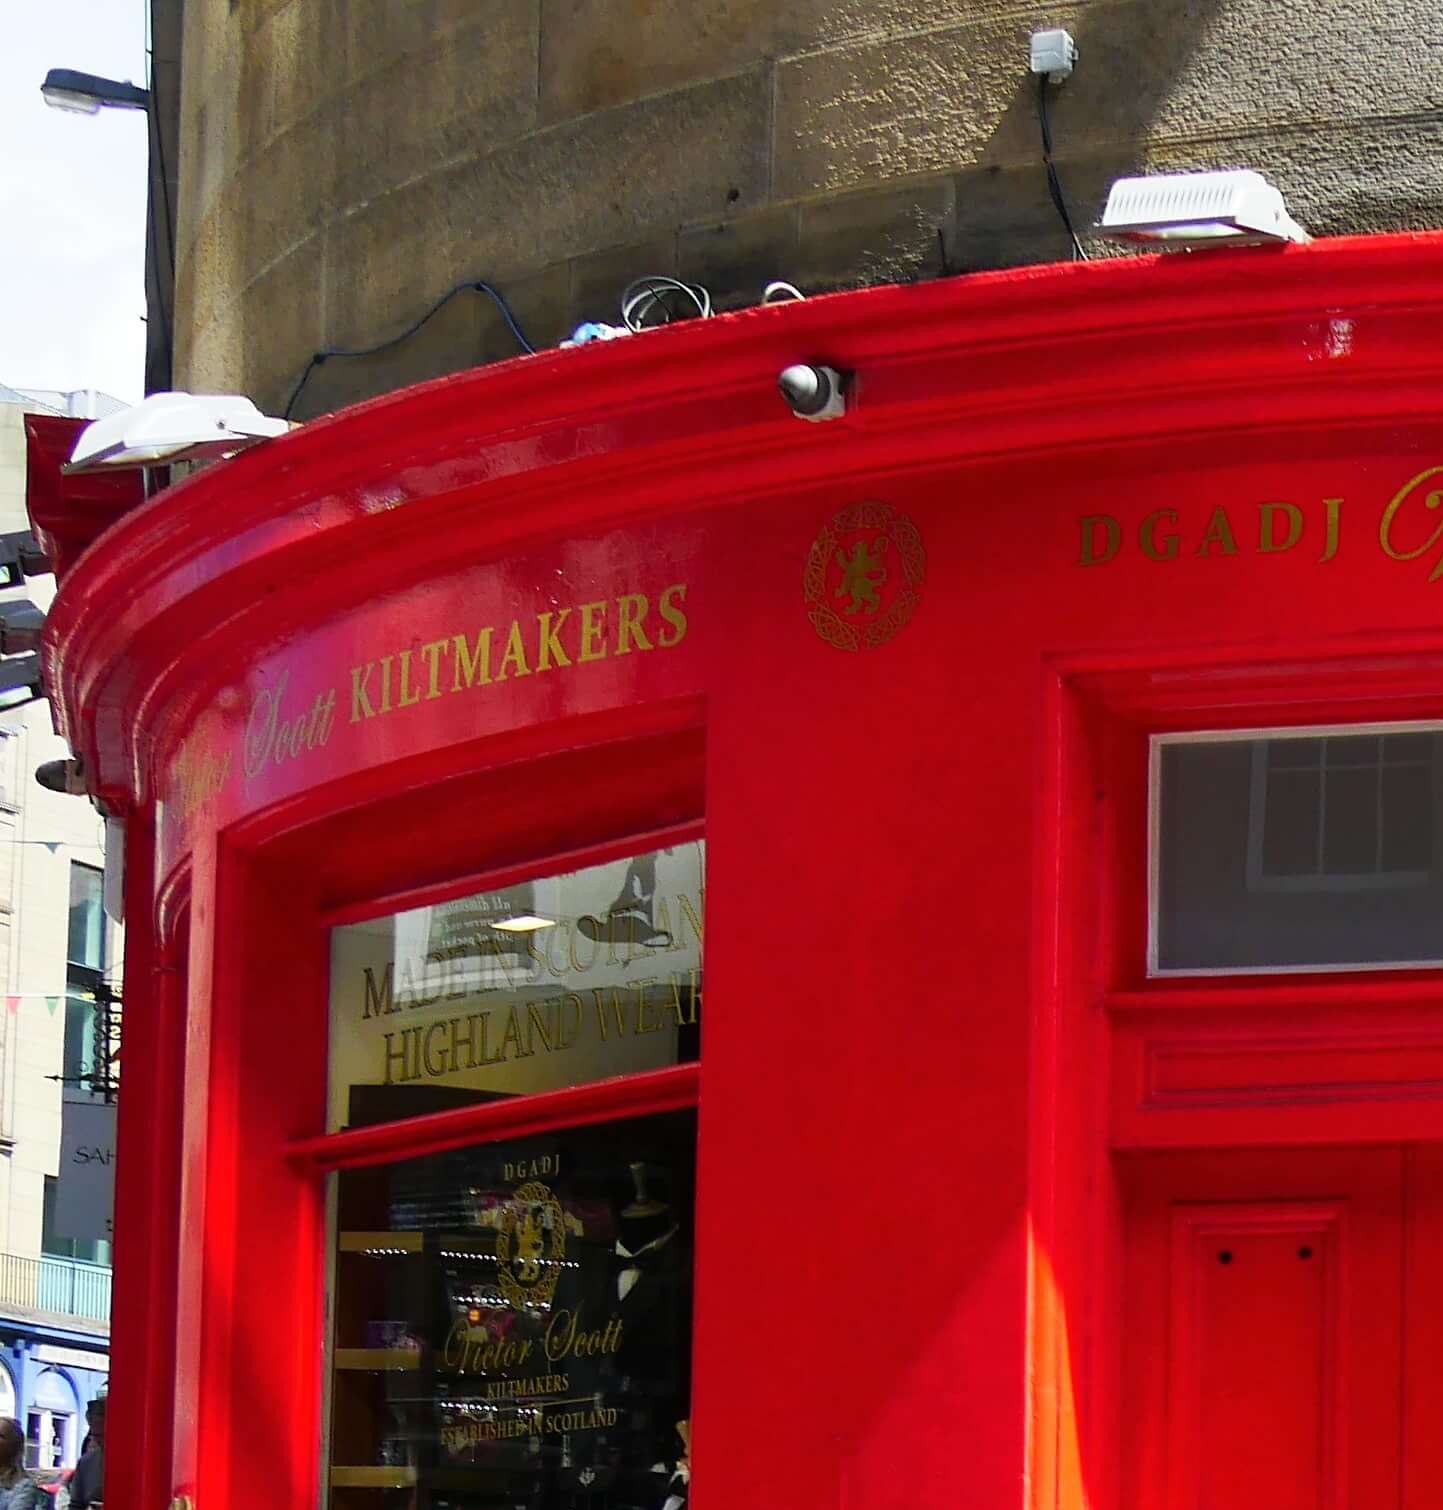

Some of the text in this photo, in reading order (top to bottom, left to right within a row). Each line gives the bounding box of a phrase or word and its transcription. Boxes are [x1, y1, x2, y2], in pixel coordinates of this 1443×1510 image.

[1078, 497, 1344, 568] DGADJ
[349, 584, 688, 723] KILTMAKERS
[526, 890, 704, 983] SCOTLAN
[383, 991, 584, 1086] HIGHLAND
[487, 1373, 569, 1399] KILTMAKERS
[546, 1408, 617, 1433] SCOTLAND
